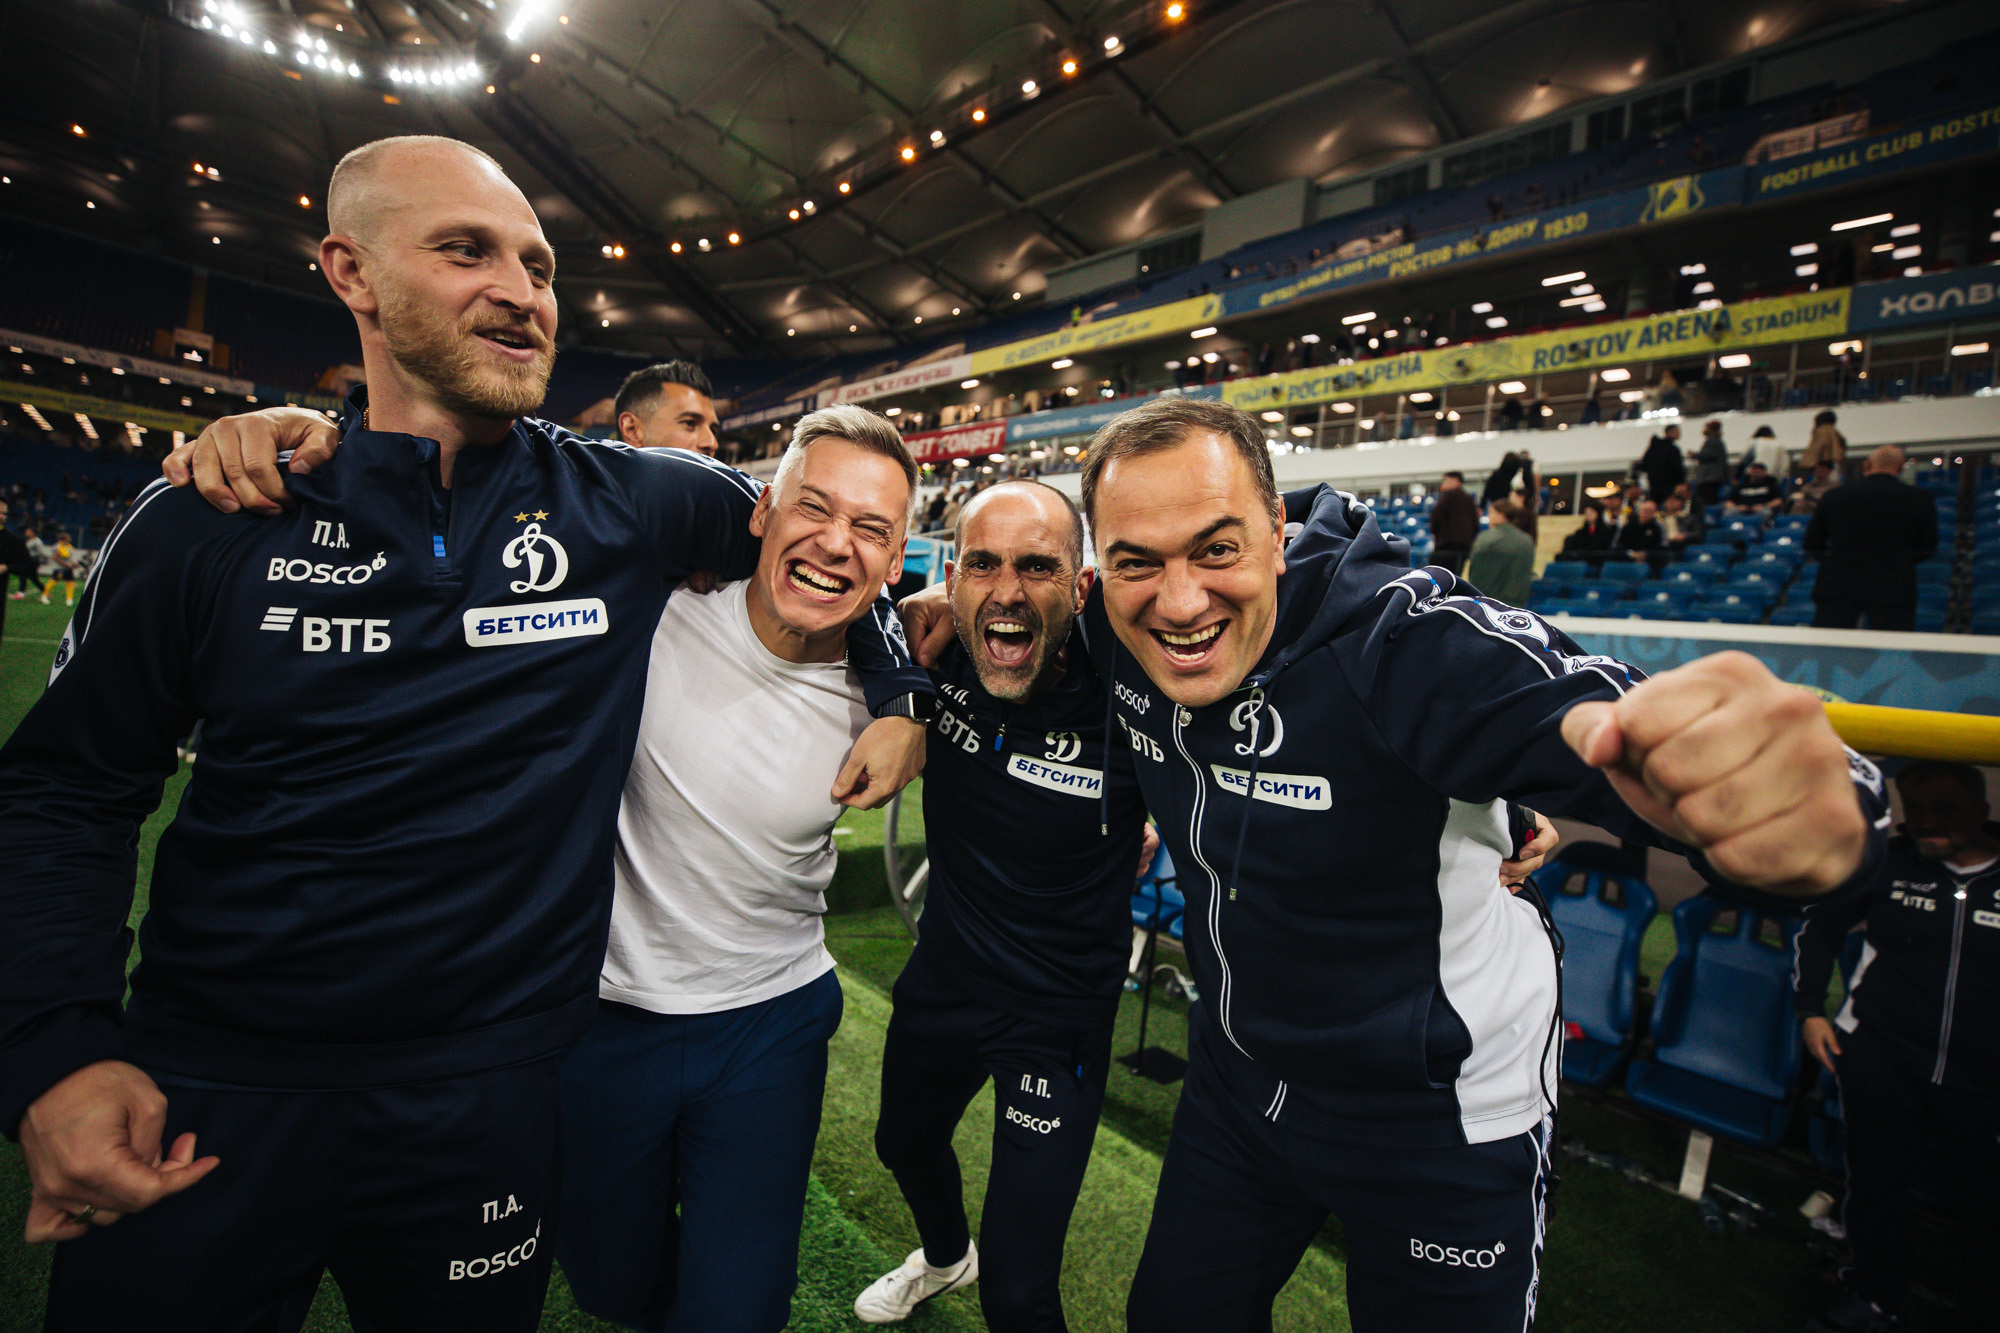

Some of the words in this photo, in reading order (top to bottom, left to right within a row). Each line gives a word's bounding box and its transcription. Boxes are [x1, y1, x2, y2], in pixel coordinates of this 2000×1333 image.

[1761, 152, 1860, 193] FOOTBALL
[1865, 131, 1923, 162] CLUB
[1532, 330, 1631, 371] ROSTOV
[1637, 309, 1733, 347] ARENA
[1740, 299, 1841, 336] STADIUM
[312, 519, 350, 549] П.А.
[267, 557, 373, 585] BOSCO
[302, 616, 391, 653] ВТБ
[476, 608, 598, 636] БЕТСИТИ
[938, 710, 981, 753] ВТБ
[1129, 725, 1165, 763] ВТБ
[1016, 758, 1101, 791] БЕТСИТИ
[1005, 1105, 1052, 1135] BOSCO
[482, 1193, 523, 1224] П.А.
[448, 1237, 537, 1281] BOSCO
[1410, 1238, 1496, 1269] BOSCO
